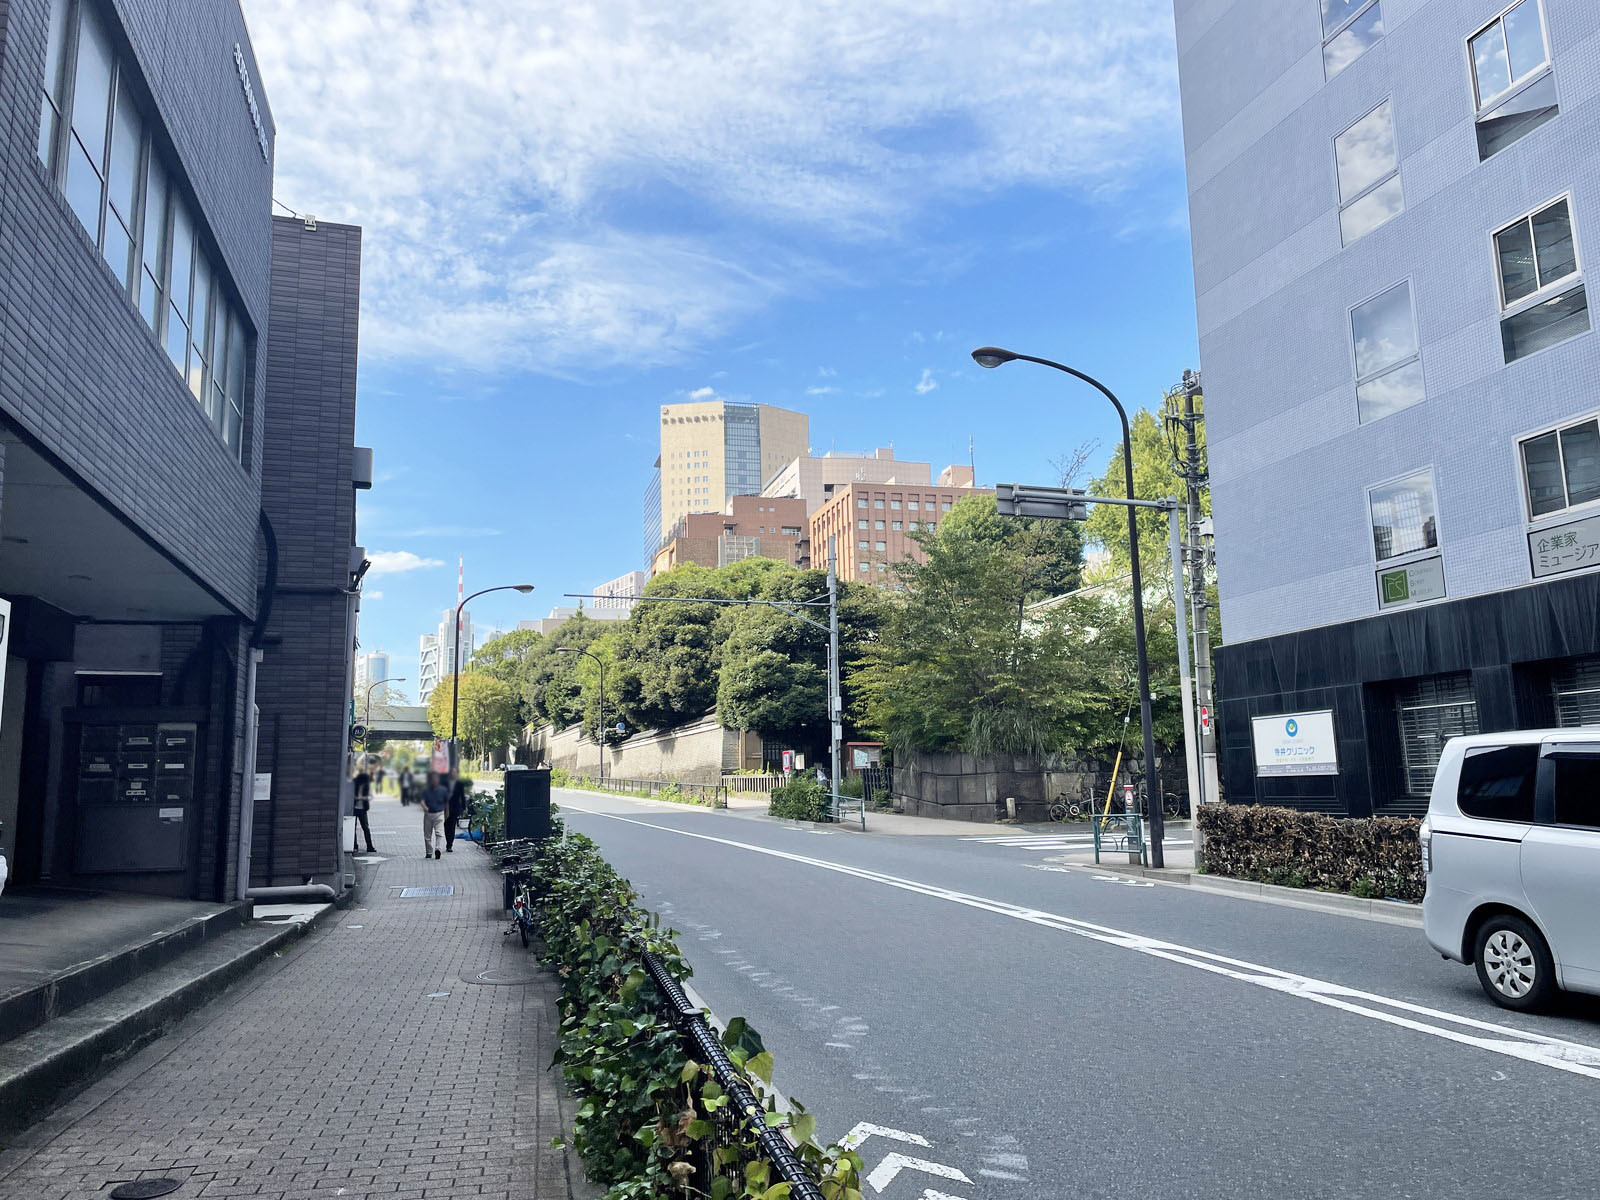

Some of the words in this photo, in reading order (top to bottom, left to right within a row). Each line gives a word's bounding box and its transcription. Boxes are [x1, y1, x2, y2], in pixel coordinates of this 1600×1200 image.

[1537, 531, 1578, 554] 企業家
[1539, 543, 1600, 569] ミュージア
